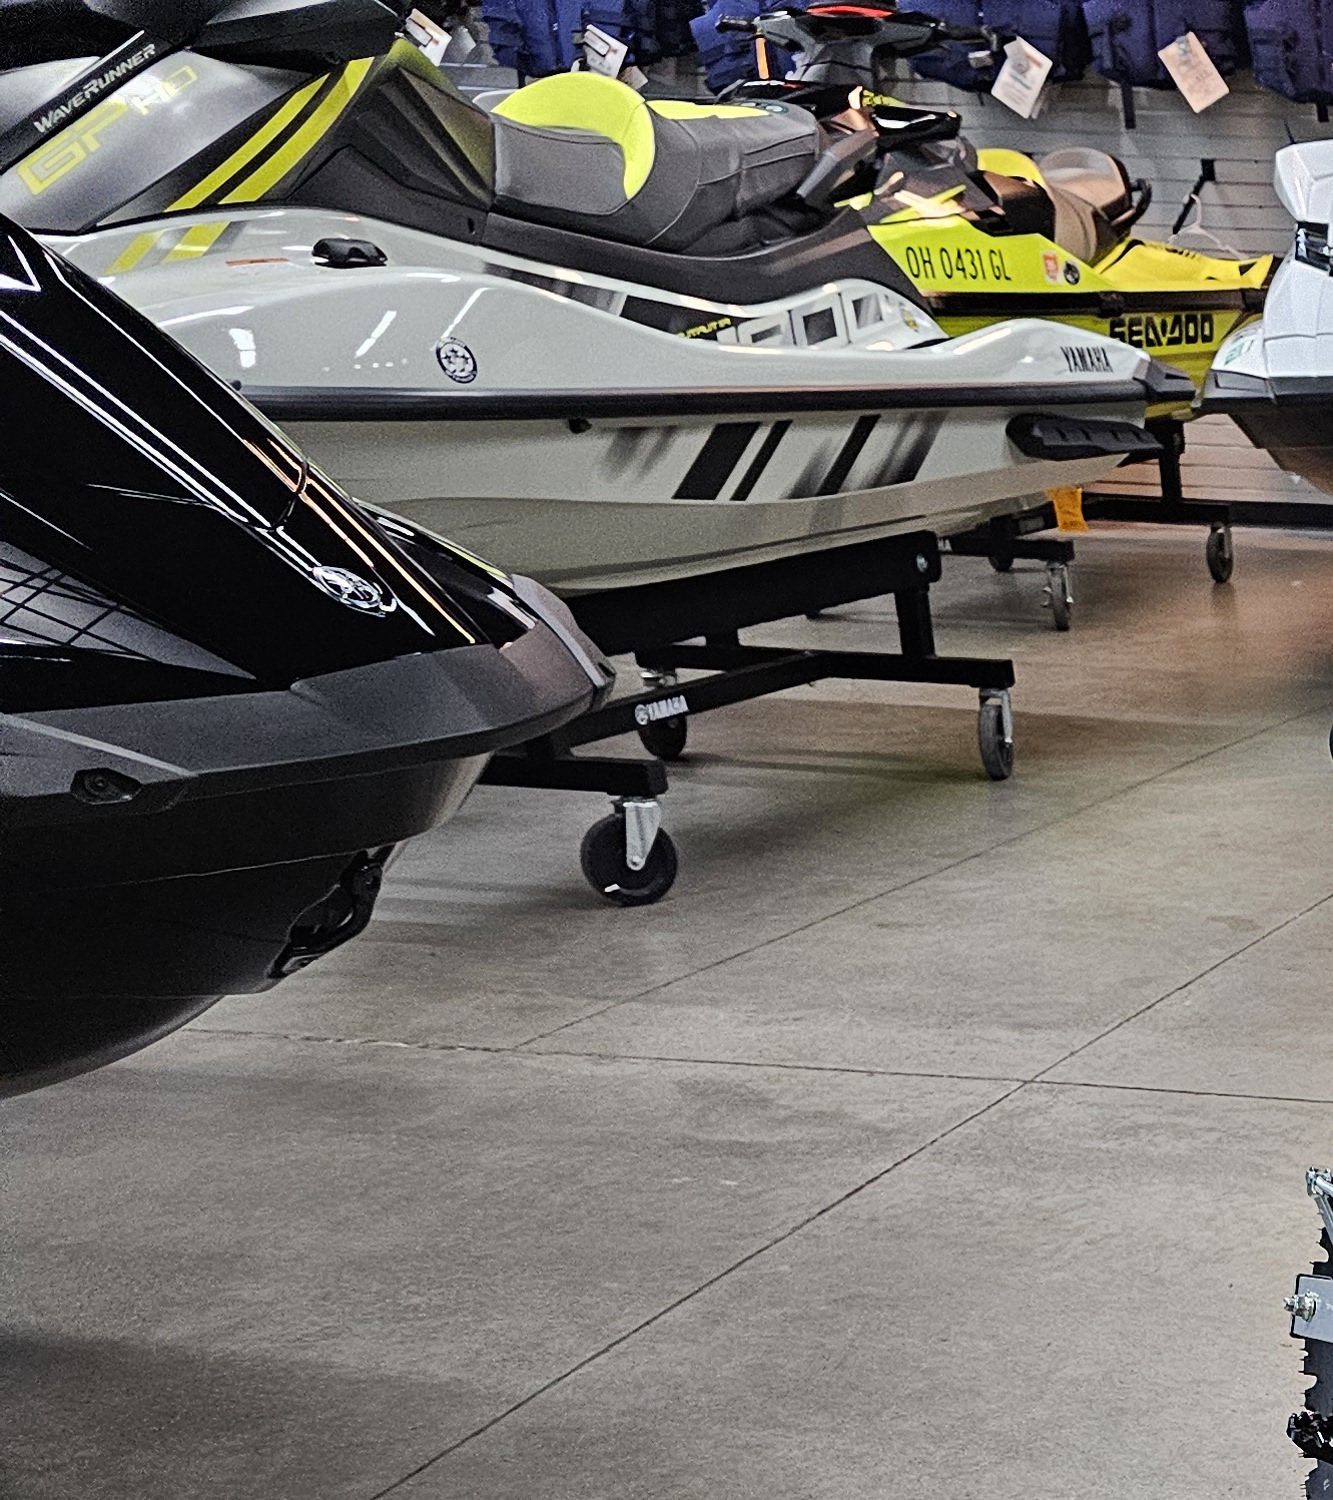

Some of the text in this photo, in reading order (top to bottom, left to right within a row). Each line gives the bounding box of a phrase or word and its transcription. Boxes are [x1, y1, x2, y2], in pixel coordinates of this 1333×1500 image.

[33, 44, 156, 133] WAVERUNNER
[906, 247, 1011, 280] OH 0431 GL
[1060, 346, 1114, 373] YAMAHA
